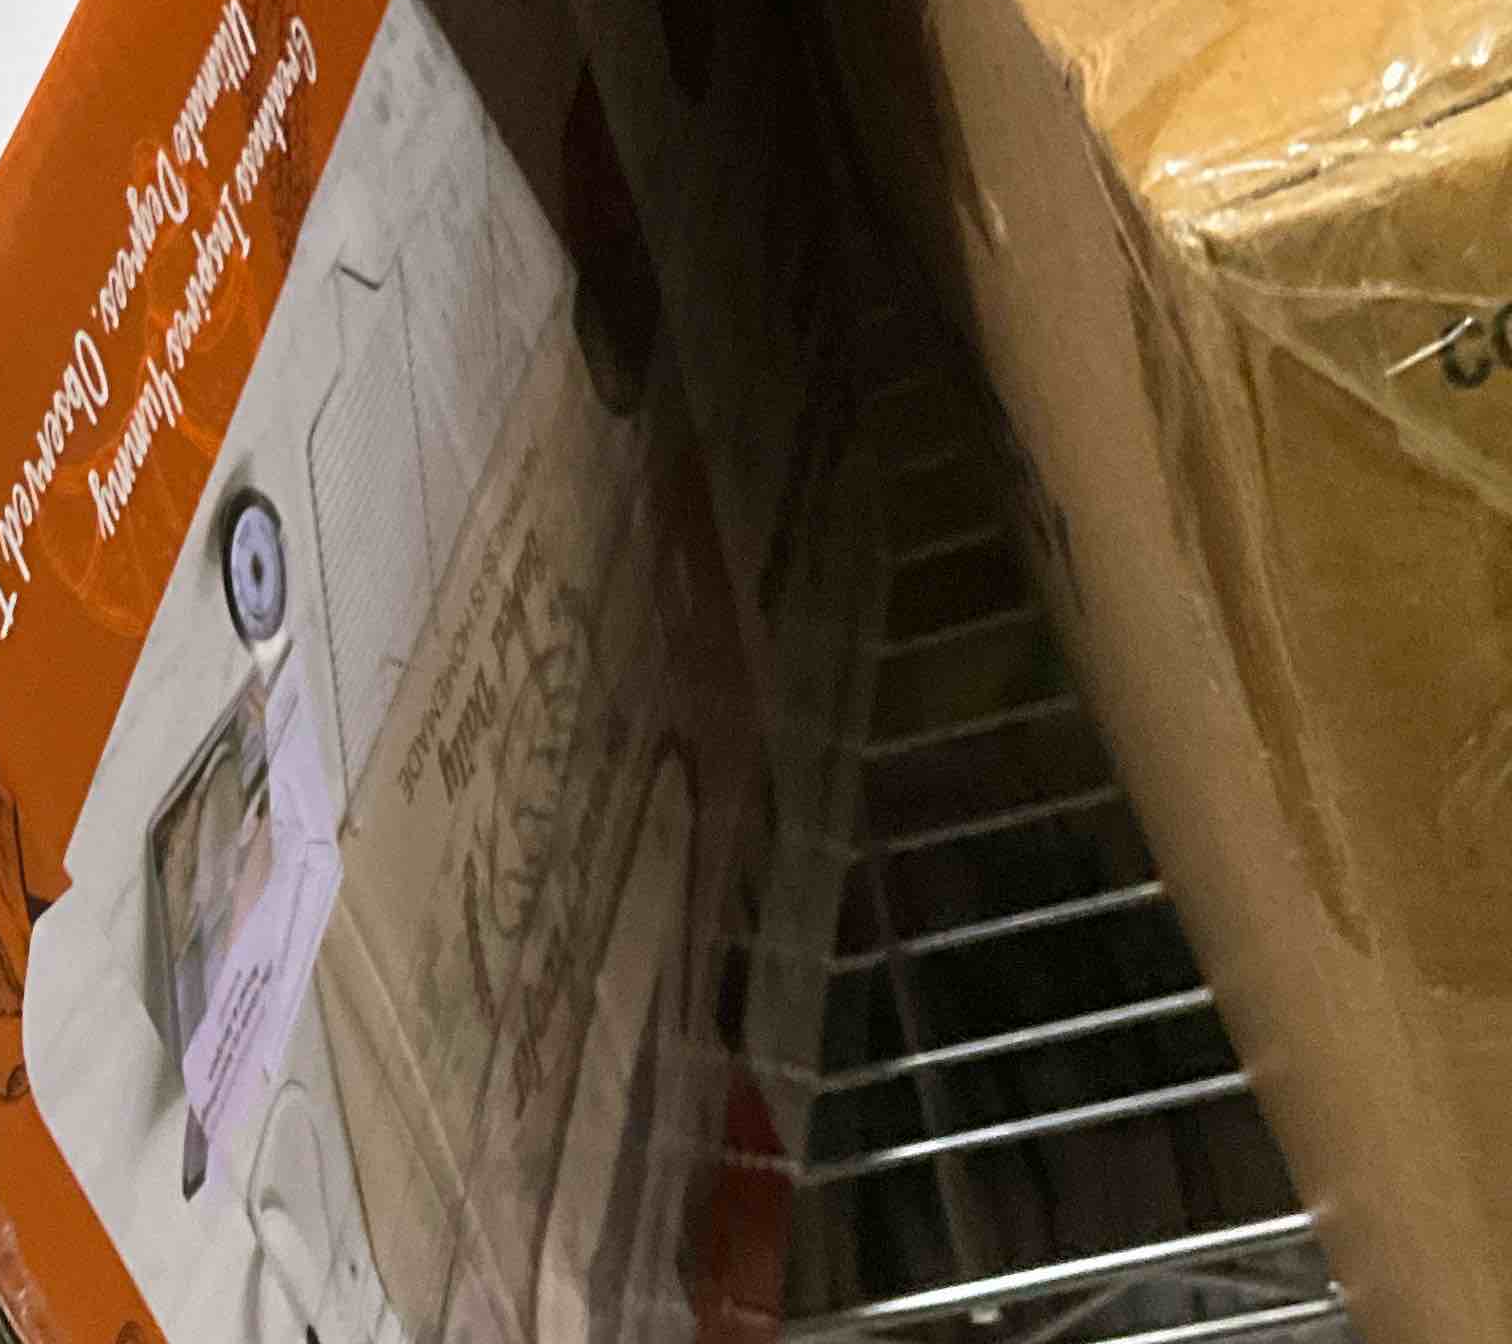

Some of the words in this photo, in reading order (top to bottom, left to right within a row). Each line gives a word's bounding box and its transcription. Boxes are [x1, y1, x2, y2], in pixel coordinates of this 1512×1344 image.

[235, 16, 317, 204] Greatness
[166, 184, 250, 373] Inspires
[87, 355, 183, 541] Yummy
